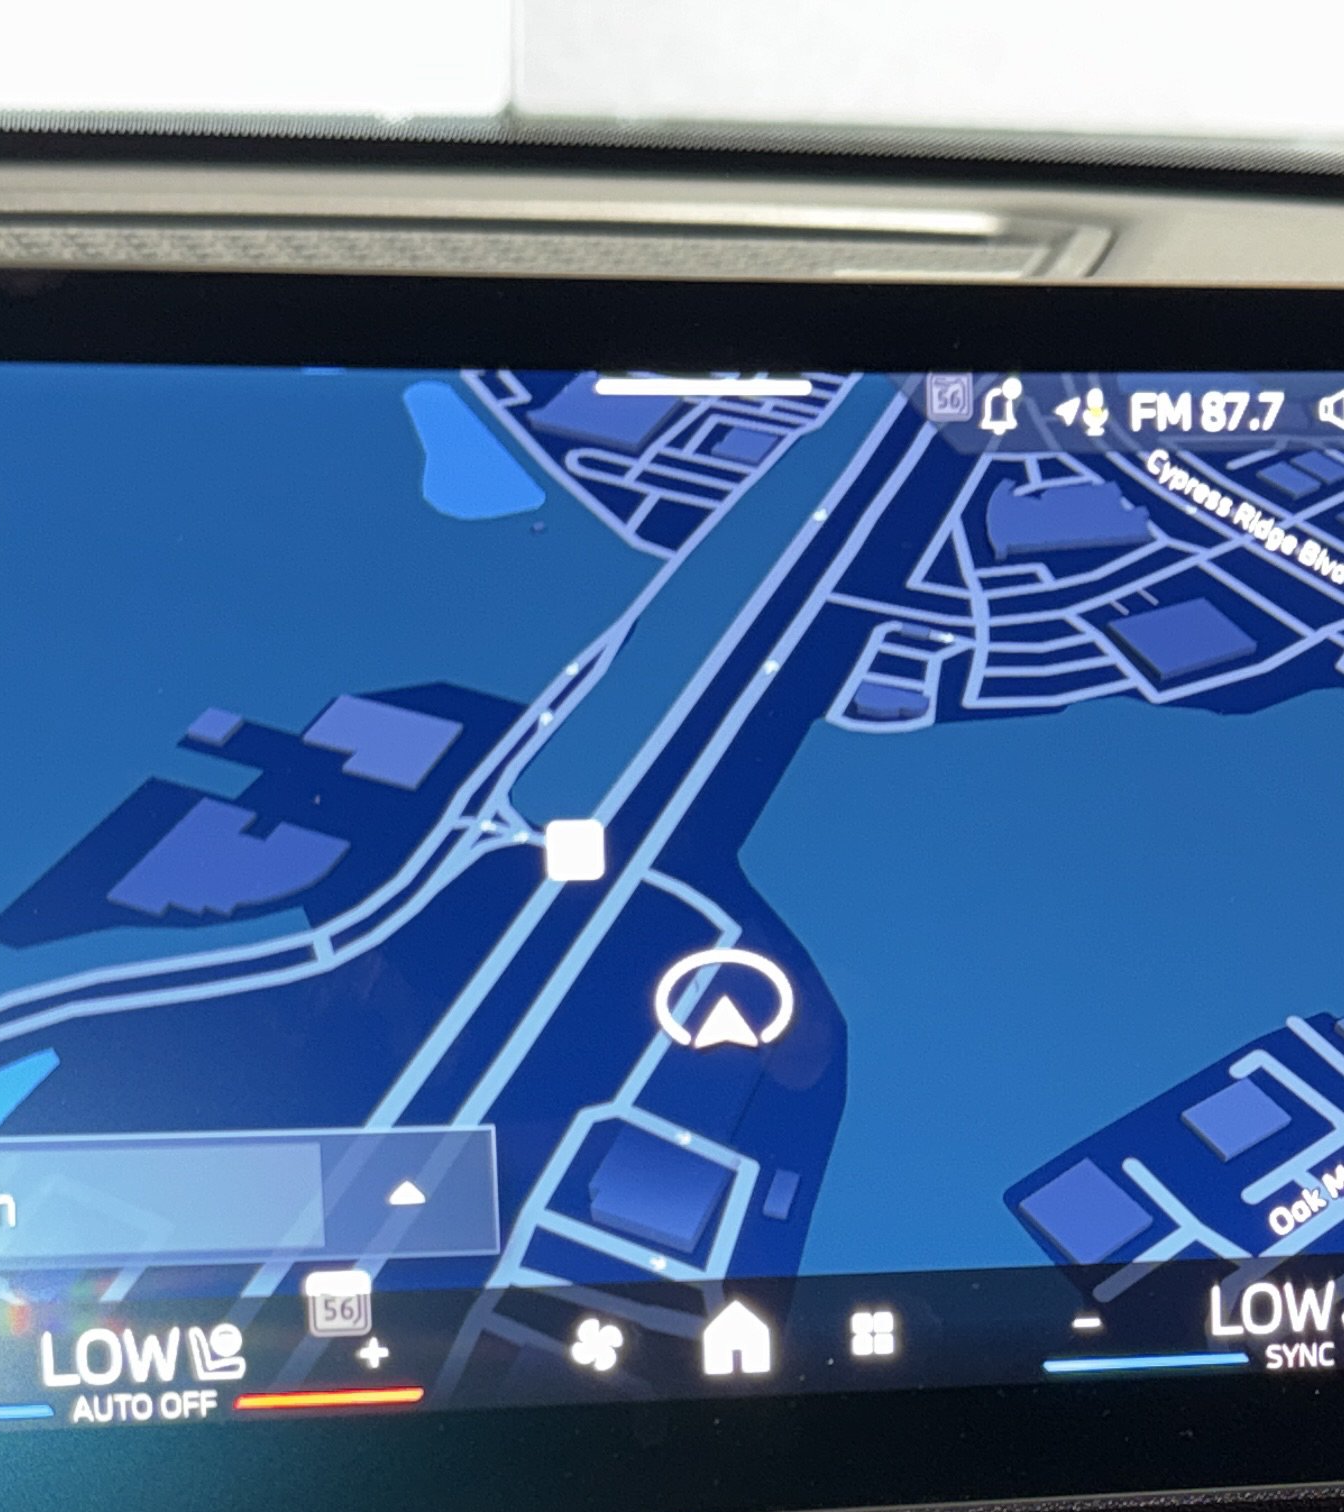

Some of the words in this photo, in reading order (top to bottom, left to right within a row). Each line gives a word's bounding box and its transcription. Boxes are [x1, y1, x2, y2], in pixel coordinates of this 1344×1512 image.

[1131, 391, 1192, 432] FM
[1200, 391, 1285, 432] 87.7
[1146, 449, 1233, 518] Cypress
[1232, 502, 1298, 556] Ridge
[1268, 1187, 1328, 1236] Oak
[1211, 1280, 1336, 1336] LOW
[40, 1326, 181, 1387] LOW
[1265, 1341, 1336, 1370] SYNC
[72, 1393, 154, 1424] AUTO
[160, 1389, 218, 1420] OFF
